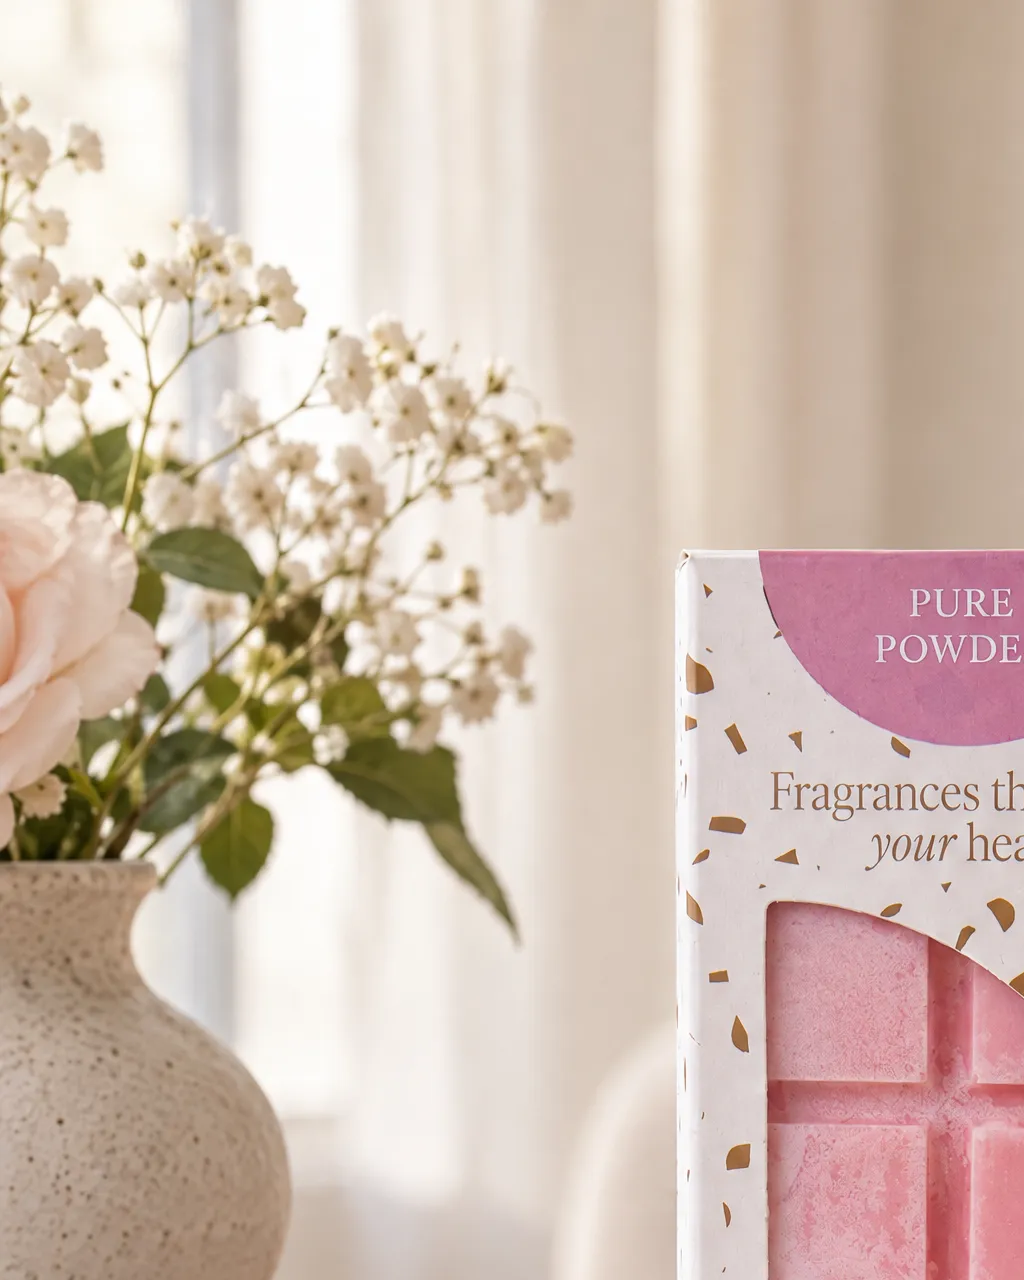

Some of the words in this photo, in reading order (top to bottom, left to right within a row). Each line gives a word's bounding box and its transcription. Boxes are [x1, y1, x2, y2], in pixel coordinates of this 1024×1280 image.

[909, 587, 1013, 618] PURE
[769, 770, 981, 822] Fragrances
[864, 832, 958, 871] your
